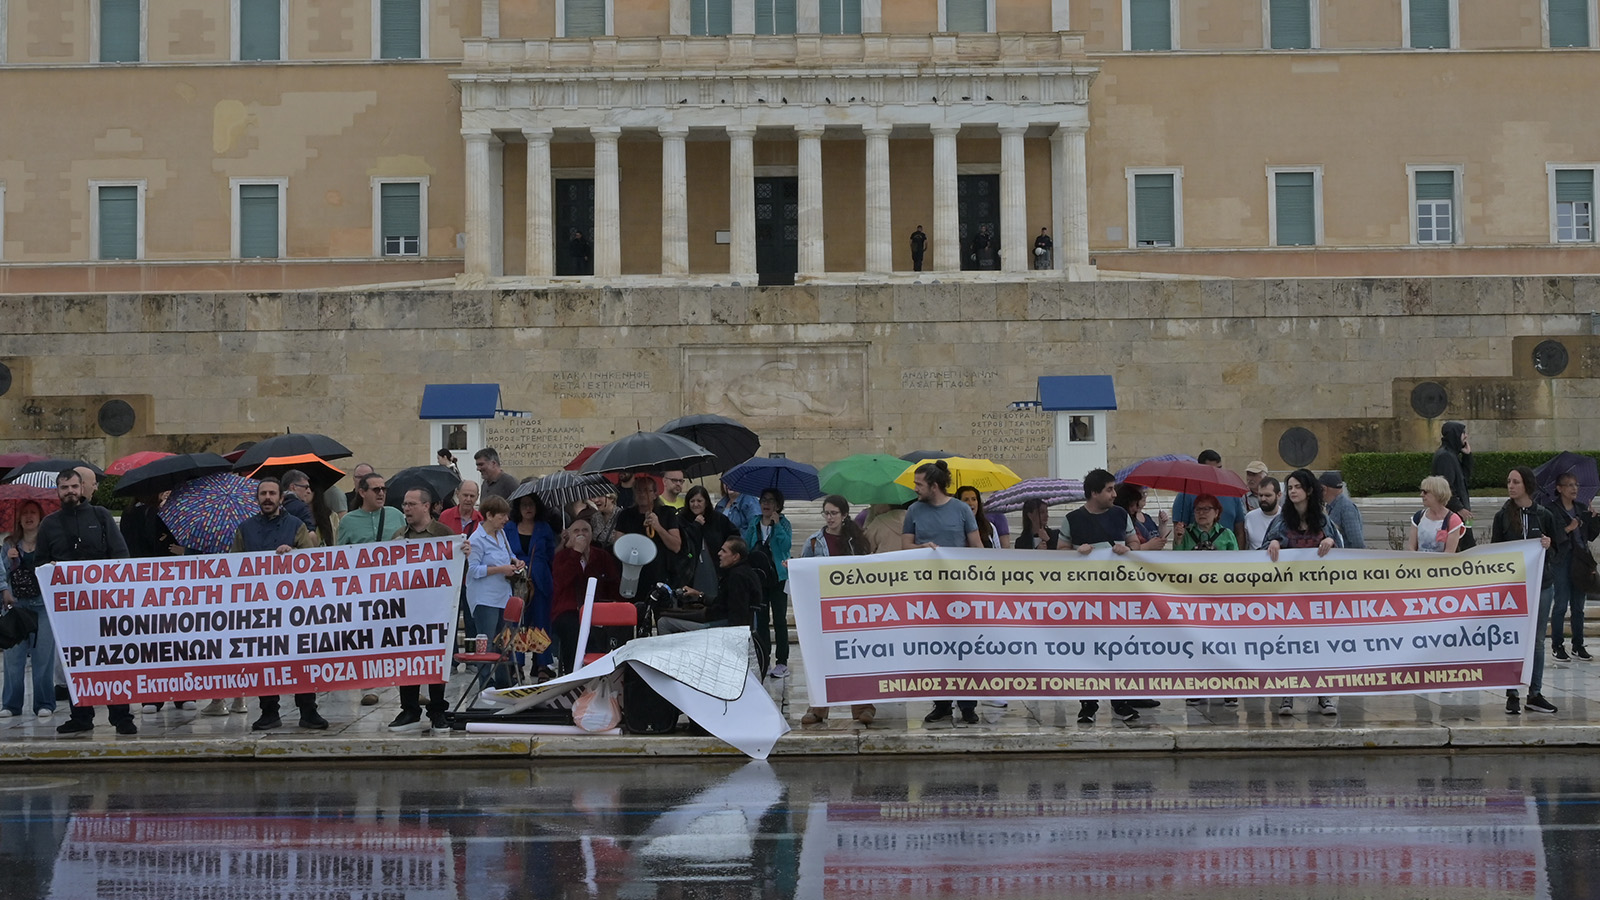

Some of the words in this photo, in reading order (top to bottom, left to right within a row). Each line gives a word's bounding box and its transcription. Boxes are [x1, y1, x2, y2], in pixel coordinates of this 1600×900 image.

[50, 558, 231, 586] ΑΠΟΚΛΕΙΣΤΙΚΑ
[238, 550, 349, 577] ΔΗΜΟΣΙΑ
[356, 541, 453, 568] ΔΩΡΕΑΝ
[829, 568, 909, 587] Θέλουμε
[913, 569, 932, 581] τα
[938, 565, 996, 581] παιδιά
[1001, 570, 1034, 585] μας
[1039, 571, 1061, 582] να
[1067, 565, 1193, 584] εκπαιδεύονται
[1198, 573, 1218, 584] σε
[1223, 566, 1293, 587] ασφαλή
[1299, 566, 1357, 585] κτήρια
[1363, 568, 1389, 580] και
[1395, 563, 1421, 579] όχι
[1426, 560, 1516, 578] αποθήκες
[54, 588, 135, 612] ΕΙΔΙΚΗ
[141, 585, 222, 607] ΑΓΩΓΗ
[231, 582, 269, 603] ΓΙΑ
[276, 578, 325, 601] ΟΛΑ
[332, 575, 362, 596] ΤΑ
[370, 567, 452, 593] ΠΑΙΔΙΑ
[831, 602, 900, 624] ΤΩΡΑ
[906, 600, 940, 620] ΝΑ
[946, 600, 1102, 620] ΦΤΙΑΧΤΟΥΝ
[1109, 601, 1161, 620] ΝΕΑ
[1166, 601, 1304, 621] ΣΥΓΧΡΟΝΑ
[1309, 599, 1397, 620] ΕΙΔΙΚΑ
[1401, 591, 1519, 616] ΣΧΟΛΕΙΑ
[100, 607, 282, 637] ΜΟΝΙΜΟΠΟΙΗΣΗ
[289, 602, 352, 627] ΟΛΩΝ
[358, 597, 406, 621] ΤΩΝ
[229, 634, 289, 659] ΣΤΗΝ
[297, 628, 374, 654] ΕΙΔΙΚΗ
[381, 622, 449, 648] ΑΓΩΓΗ
[834, 638, 894, 660] Είναι
[902, 634, 1038, 660] υποχρέωση
[1044, 641, 1085, 655] του
[1094, 634, 1194, 661] κράτους
[1202, 641, 1236, 655] και
[1244, 634, 1319, 660] πρέπει
[1326, 639, 1356, 654] να
[1363, 636, 1404, 652] την
[1412, 624, 1519, 651] αναλάβει
[136, 668, 259, 694] Εκπαιδευτικών
[263, 666, 298, 687] Π.Ε.
[303, 661, 358, 684] "ΡΟΖΑ
[878, 677, 942, 693] ΕΝΙΑΙΟΣ
[945, 677, 1038, 691] ΣΥΛΛΟΓΟΣ
[1041, 677, 1110, 691] ΓΟΝΕΩΝ
[1115, 677, 1144, 691] ΚΑΙ
[1148, 677, 1260, 691] ΚΗΔΕΜΟΝΩΝ
[1263, 676, 1311, 689] ΑΜΕΑ
[1315, 672, 1387, 688] ΑΤΤΙΚΗΣ
[1390, 671, 1420, 685] ΚΑΙ
[1424, 668, 1483, 684] ΝΗΣΩΝ
